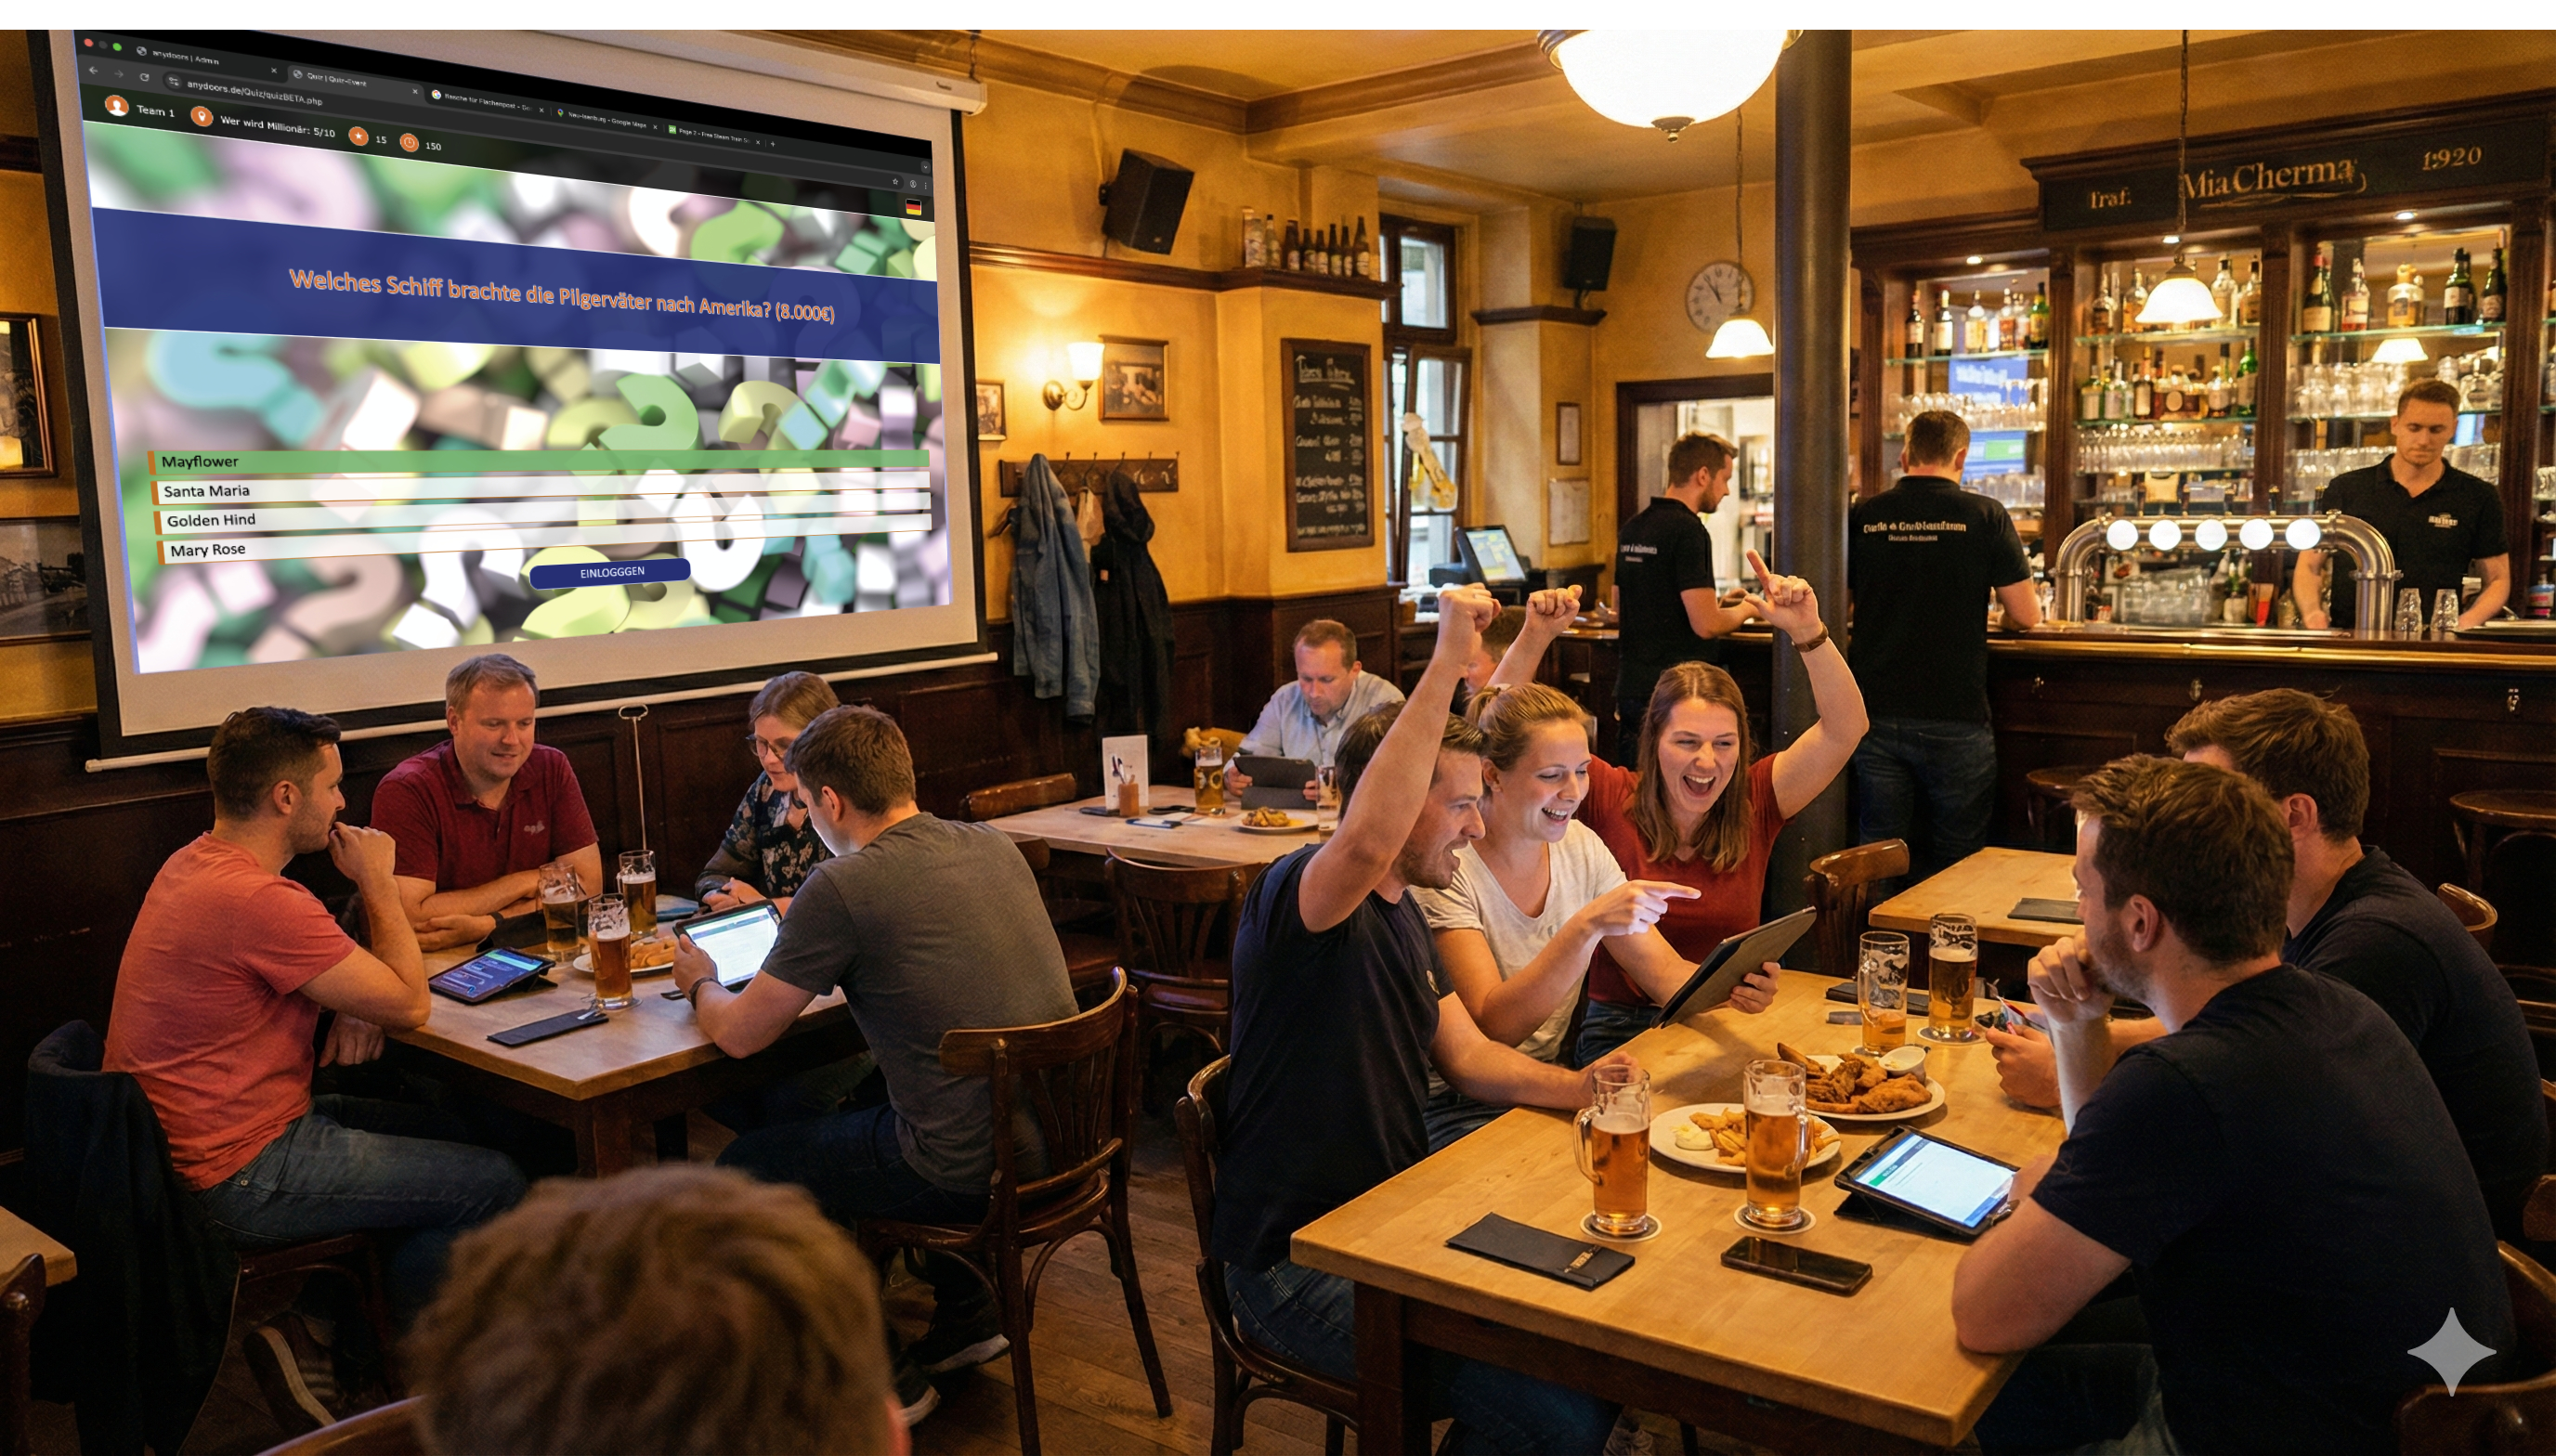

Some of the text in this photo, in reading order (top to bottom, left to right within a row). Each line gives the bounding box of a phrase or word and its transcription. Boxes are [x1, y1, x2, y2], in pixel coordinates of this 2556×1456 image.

[152, 50, 189, 60] anydoors
[195, 56, 219, 65] Admin
[307, 72, 323, 82] Quiz
[329, 76, 367, 87] Quiz-Event
[187, 81, 323, 106] anydoors.de/Quiz/quizBETA.php
[136, 104, 175, 118] Team 1
[220, 115, 335, 137] Wer wird Millionär: 5/10
[612, 118, 631, 126] Google
[375, 136, 387, 144] 15
[425, 142, 442, 150] 150
[289, 268, 836, 325] Welches Schiff brachte die Pilgerväter nach Amerika? (8.000€)
[162, 455, 240, 470] Mayflower
[163, 485, 250, 498] Santa Maria
[167, 513, 255, 527] Golden Hind
[171, 543, 246, 558] Mary Rose
[580, 566, 645, 578] EINLOGGGEN
